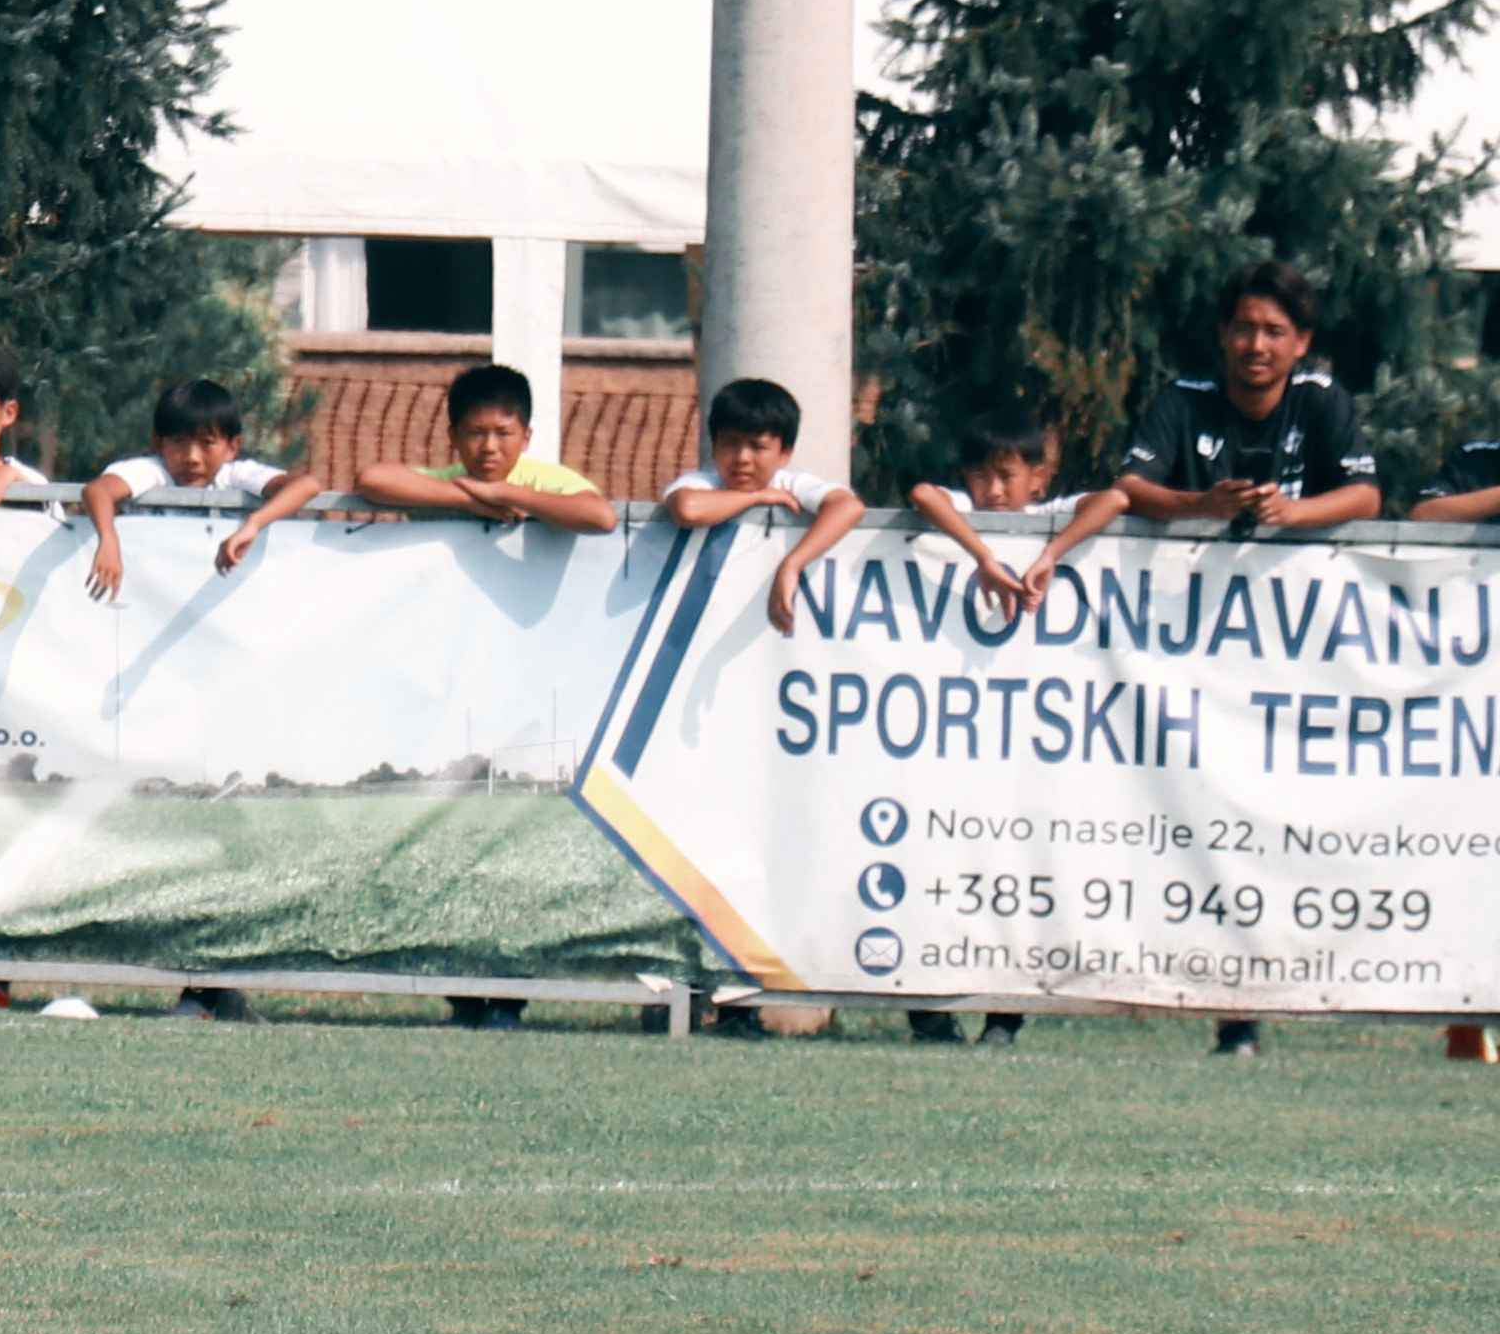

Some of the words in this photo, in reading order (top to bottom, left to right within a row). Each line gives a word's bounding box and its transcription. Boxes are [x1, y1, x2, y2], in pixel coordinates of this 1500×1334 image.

[776, 669, 1200, 769] SPORTSKIH
[1250, 691, 1500, 777] TEREN
[927, 809, 1033, 841] Novo
[1050, 815, 1193, 855] naselje
[1207, 819, 1265, 856] 22,
[925, 873, 1055, 918] +385
[1083, 878, 1134, 921] 91
[1163, 881, 1264, 927] 949
[1293, 887, 1432, 931] 6939
[920, 936, 1442, 987] adm.solar.hr@gmail.com
